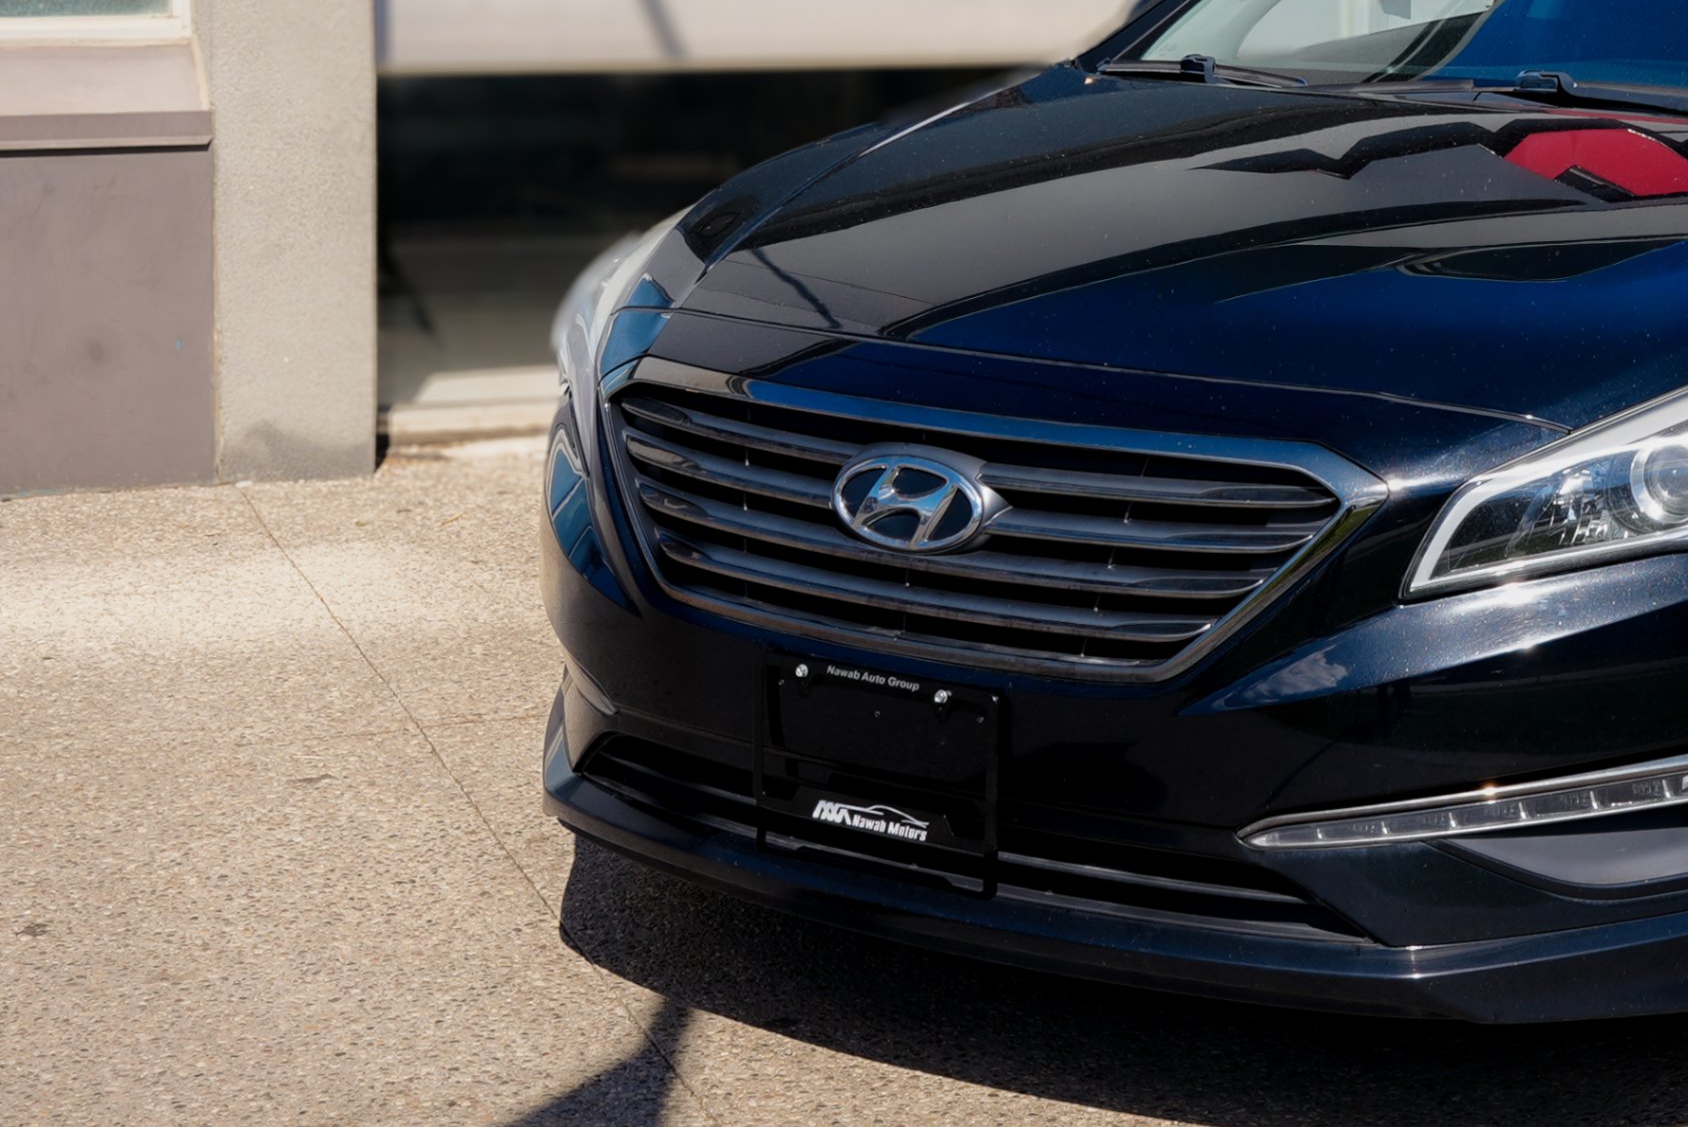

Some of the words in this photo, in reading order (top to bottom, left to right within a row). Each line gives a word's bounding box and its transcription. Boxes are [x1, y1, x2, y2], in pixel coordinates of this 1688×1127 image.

[826, 664, 861, 680] Nawab
[861, 671, 887, 685] Auto
[887, 676, 920, 692] Group
[852, 813, 887, 833] Nawab
[887, 821, 928, 841] Motors
